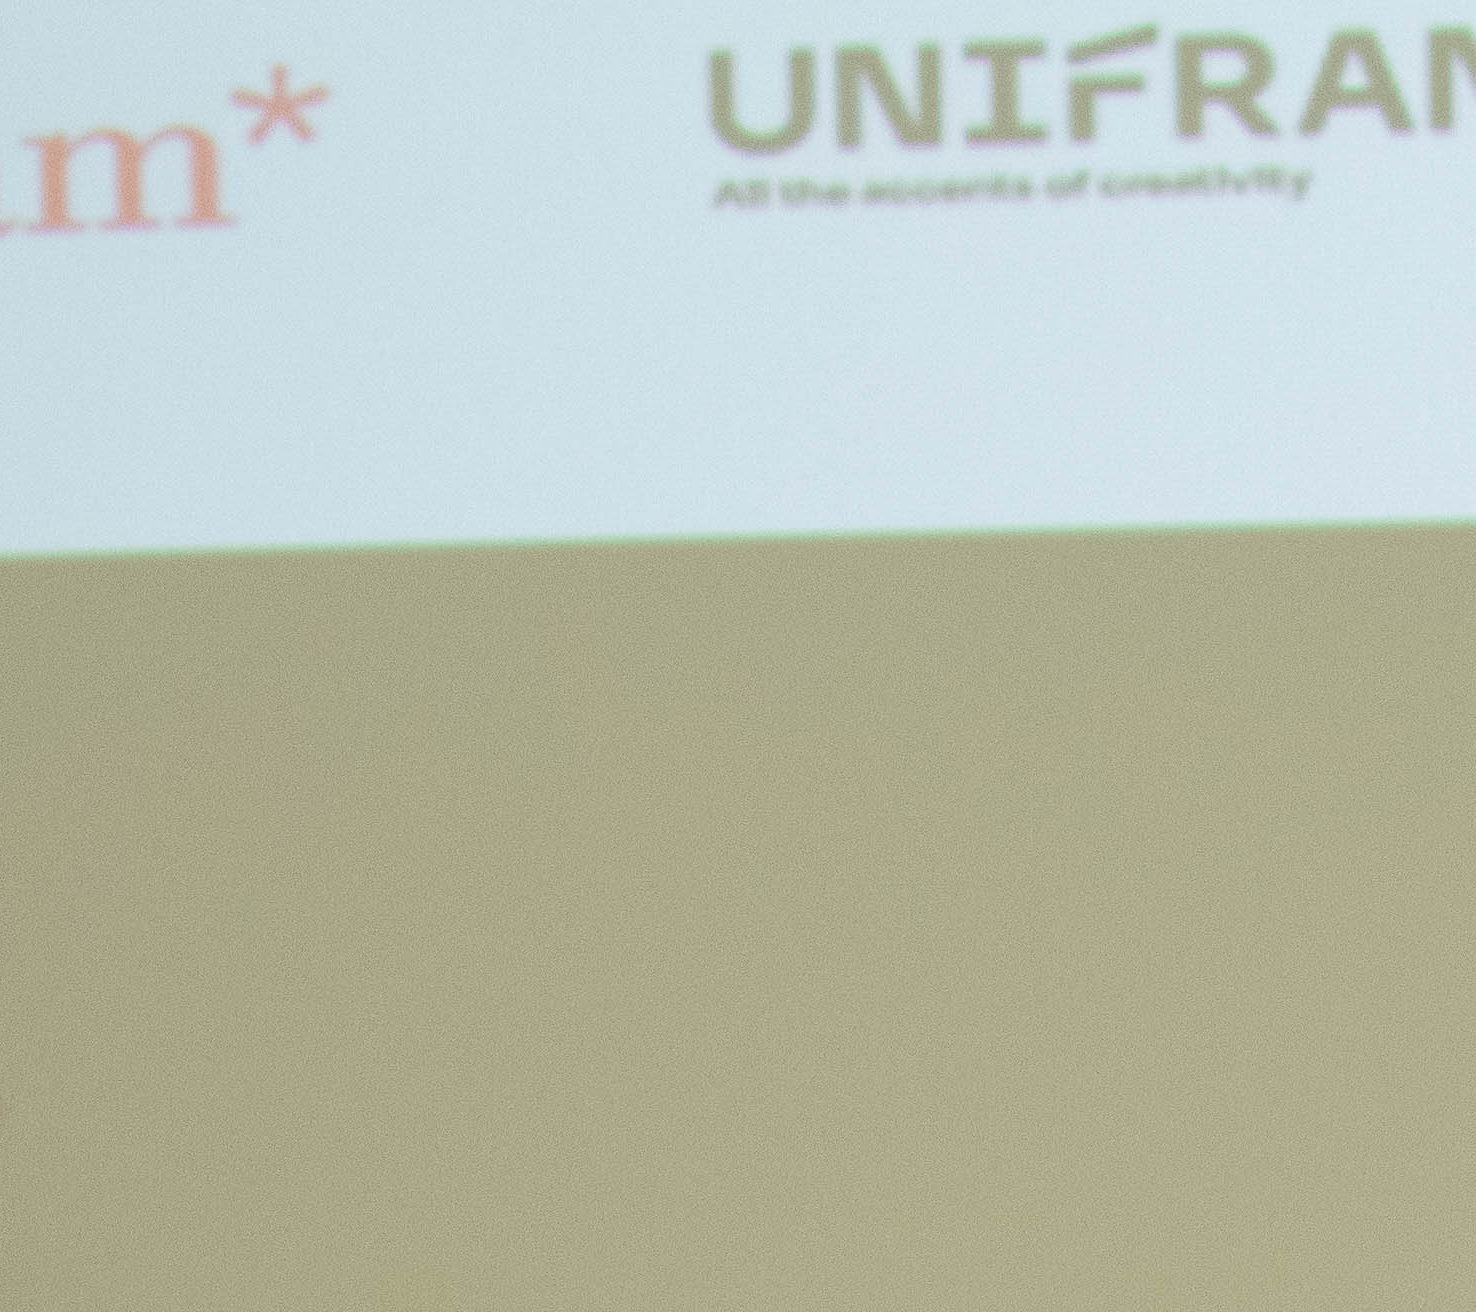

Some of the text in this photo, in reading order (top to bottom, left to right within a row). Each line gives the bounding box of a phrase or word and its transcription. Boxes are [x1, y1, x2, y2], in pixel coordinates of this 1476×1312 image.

[714, 164, 1312, 208] All the accents of creativity
